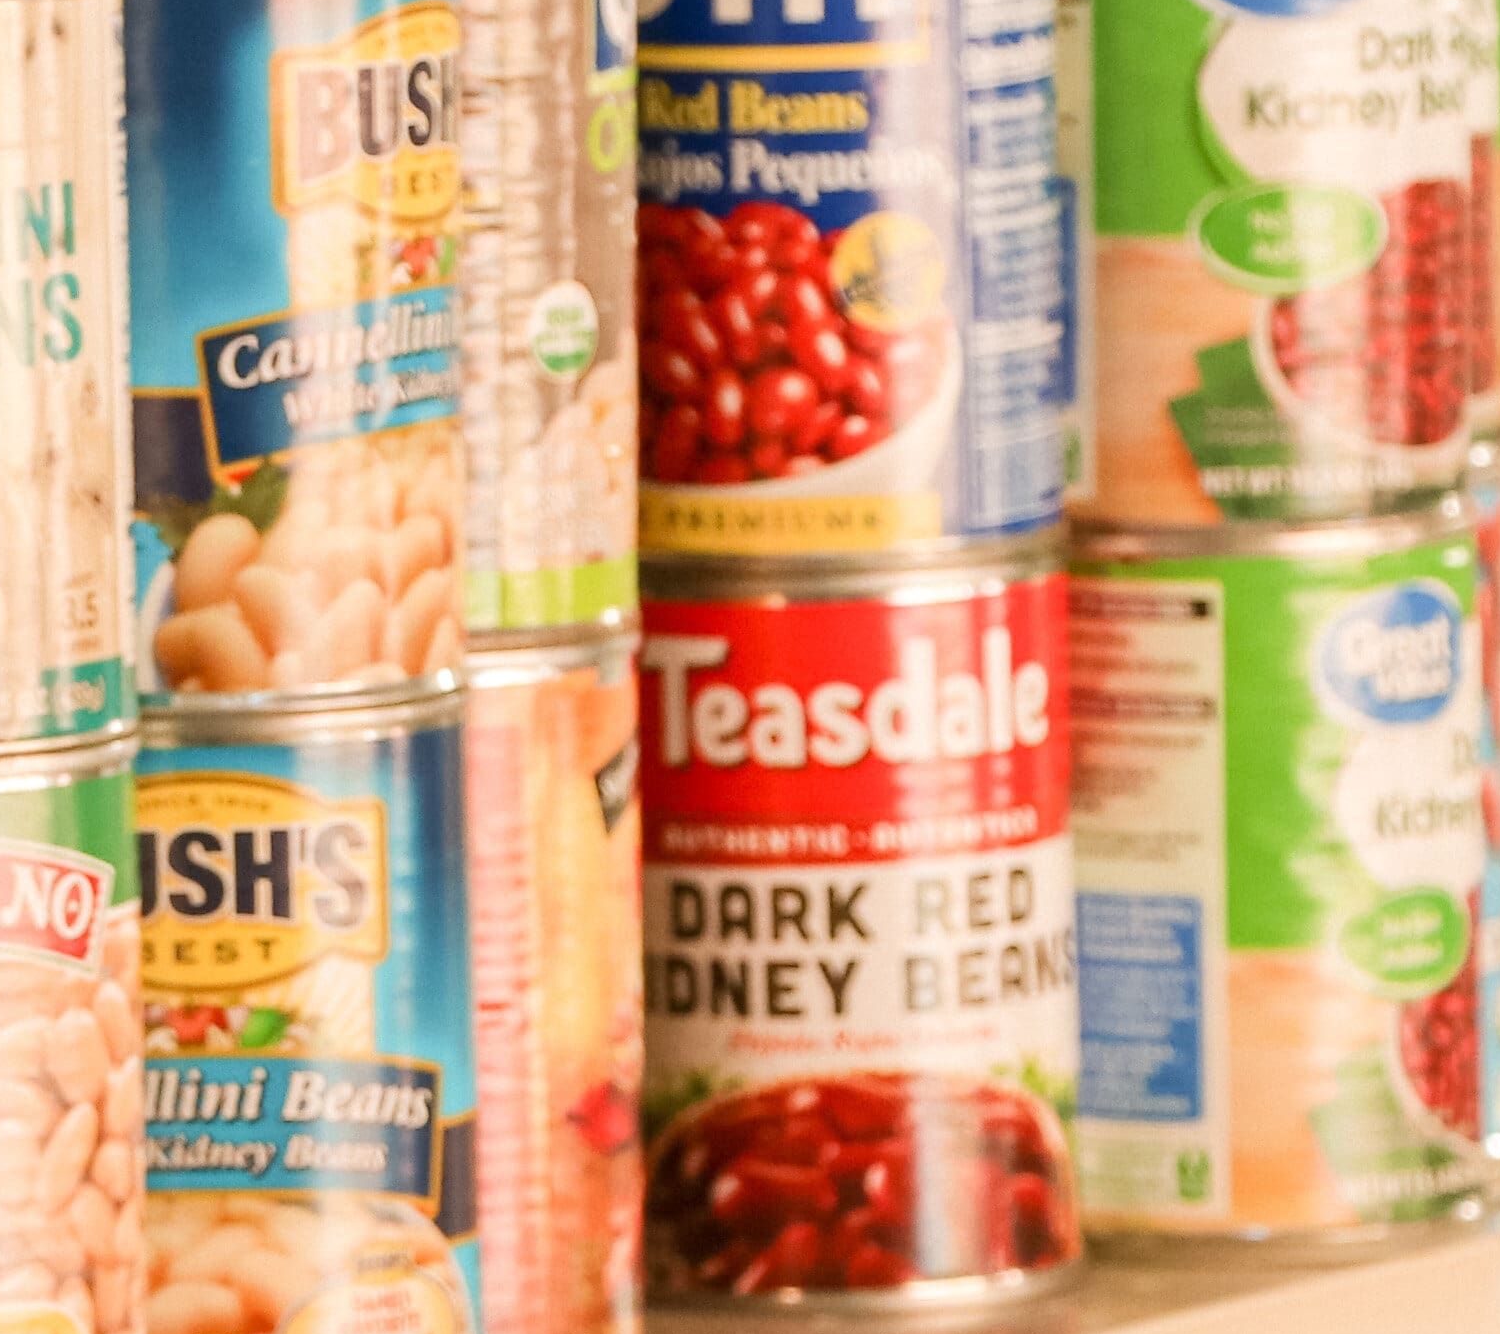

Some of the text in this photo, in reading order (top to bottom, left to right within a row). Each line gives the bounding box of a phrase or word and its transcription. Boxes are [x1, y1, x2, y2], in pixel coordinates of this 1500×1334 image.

[638, 626, 1050, 769] Teasdale
[668, 867, 1036, 942] DARK RED
[283, 1069, 434, 1129] Beans
[284, 1135, 389, 1174] Beans
